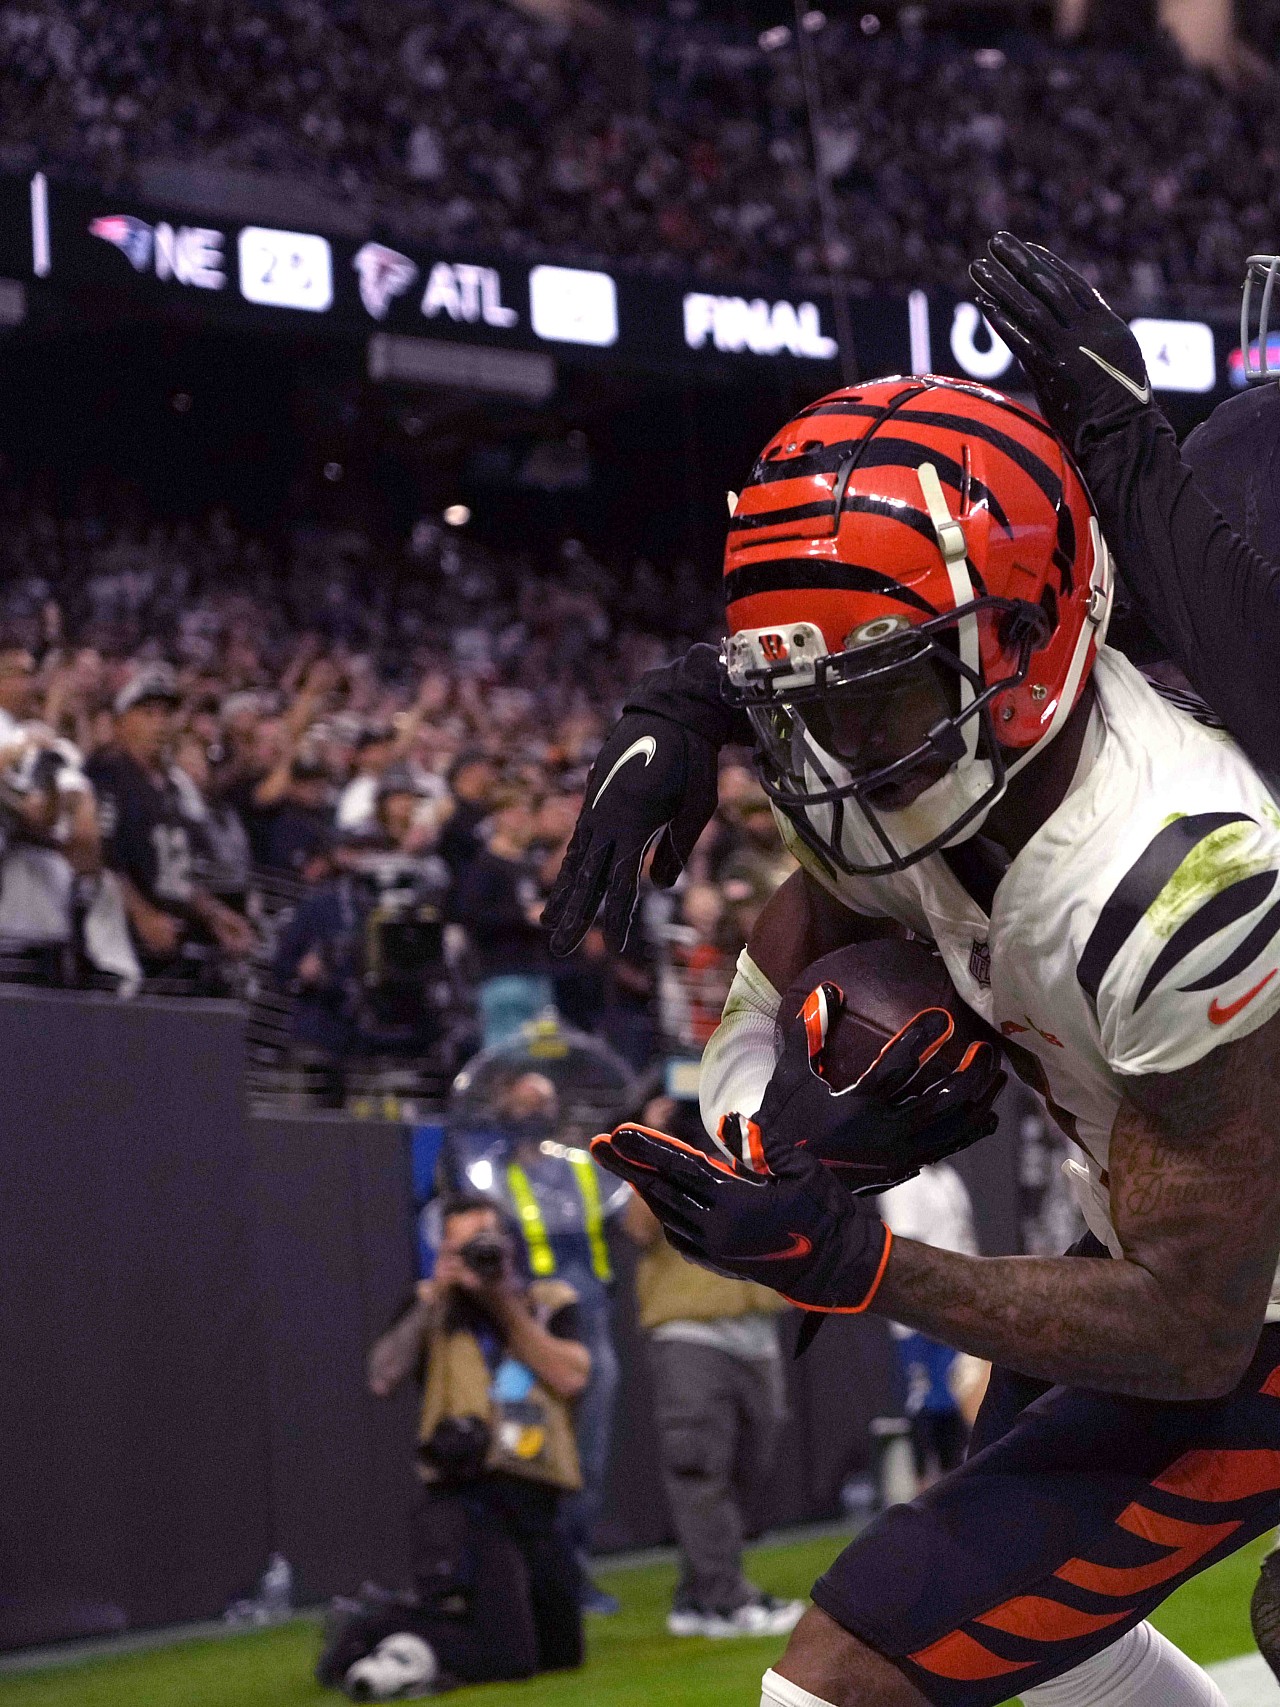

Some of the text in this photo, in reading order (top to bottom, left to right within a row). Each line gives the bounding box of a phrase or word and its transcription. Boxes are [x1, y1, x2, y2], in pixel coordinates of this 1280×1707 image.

[154, 220, 227, 290] NE
[421, 261, 518, 328] ATL
[683, 291, 839, 360] FINAL
